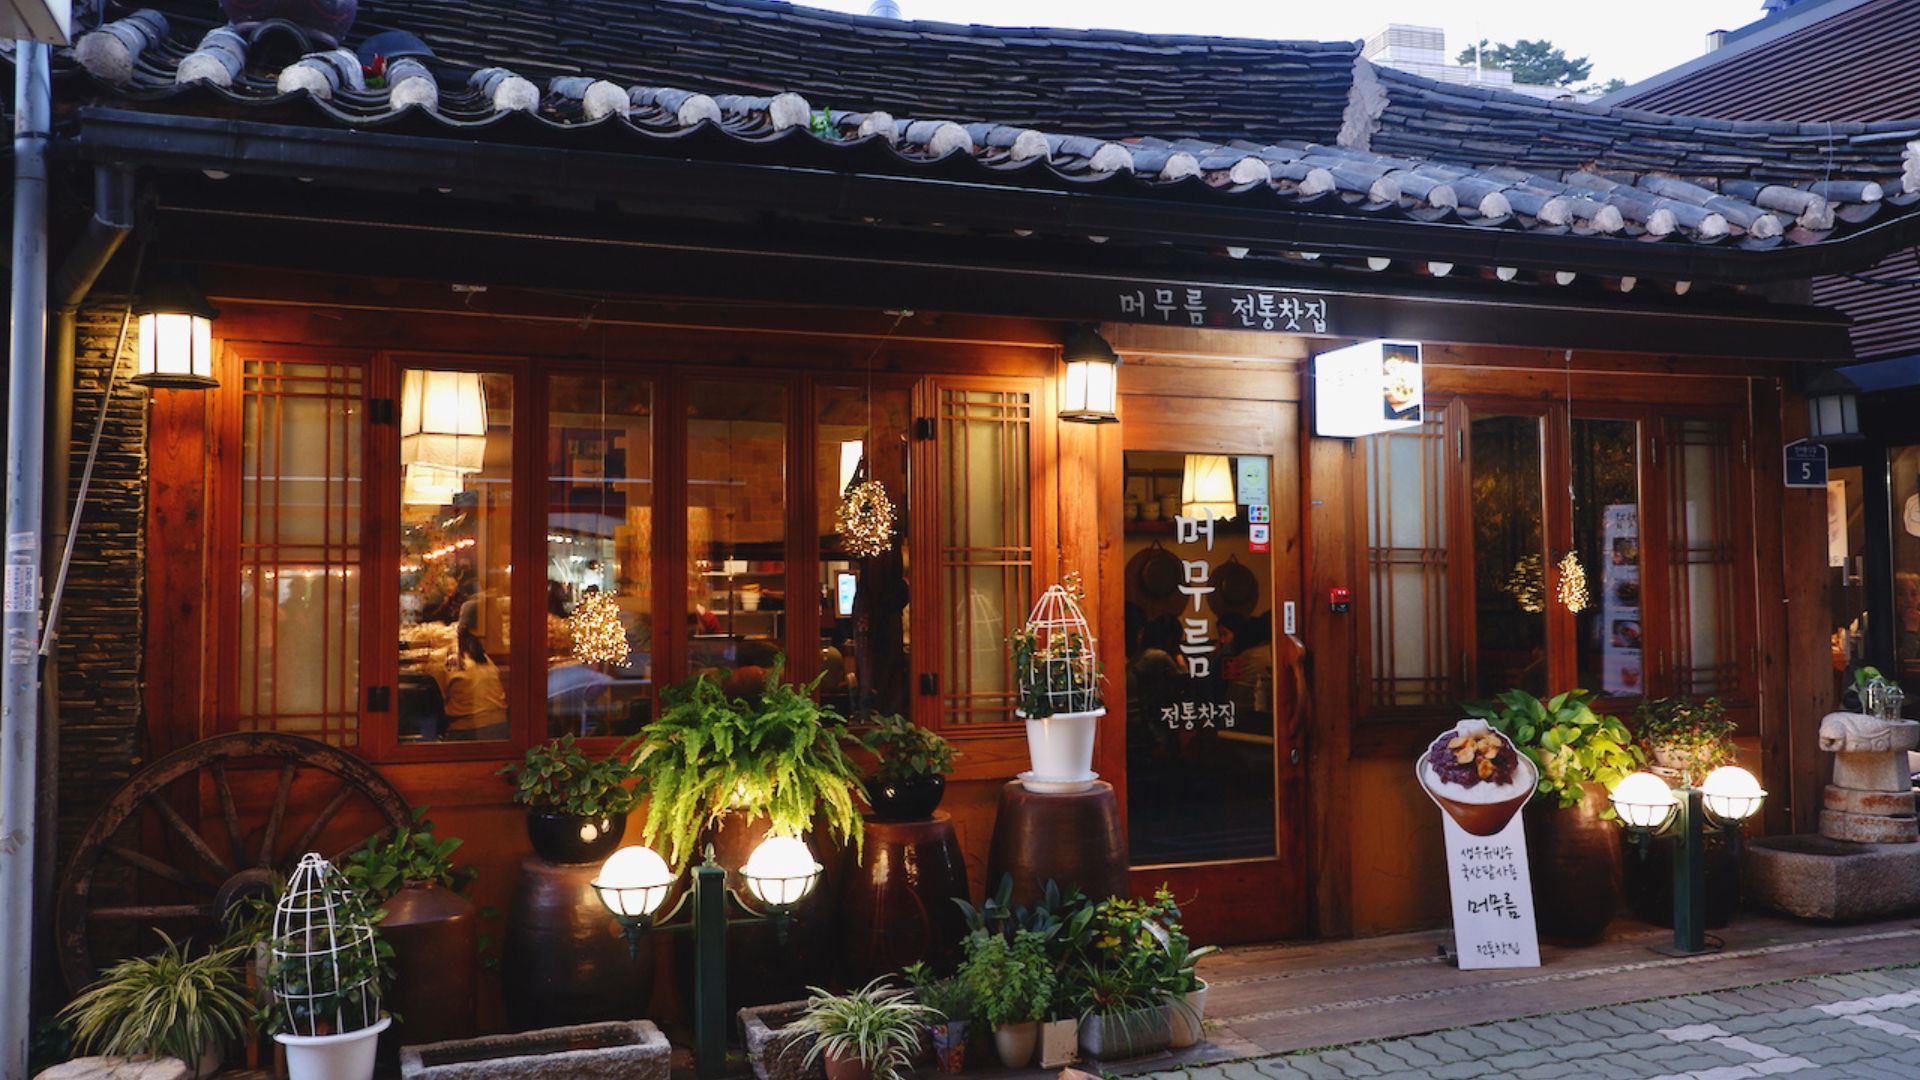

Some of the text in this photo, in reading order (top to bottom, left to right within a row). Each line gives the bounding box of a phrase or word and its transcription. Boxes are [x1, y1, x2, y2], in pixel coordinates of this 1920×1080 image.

[1119, 288, 1328, 333] 머무름 전통찻집
[1801, 462, 1812, 480] 5
[1174, 507, 1216, 679] 머무름
[1160, 700, 1236, 730] 전통찻집
[1460, 846, 1514, 860] 생우유빙수
[1467, 892, 1521, 919] 머무름
